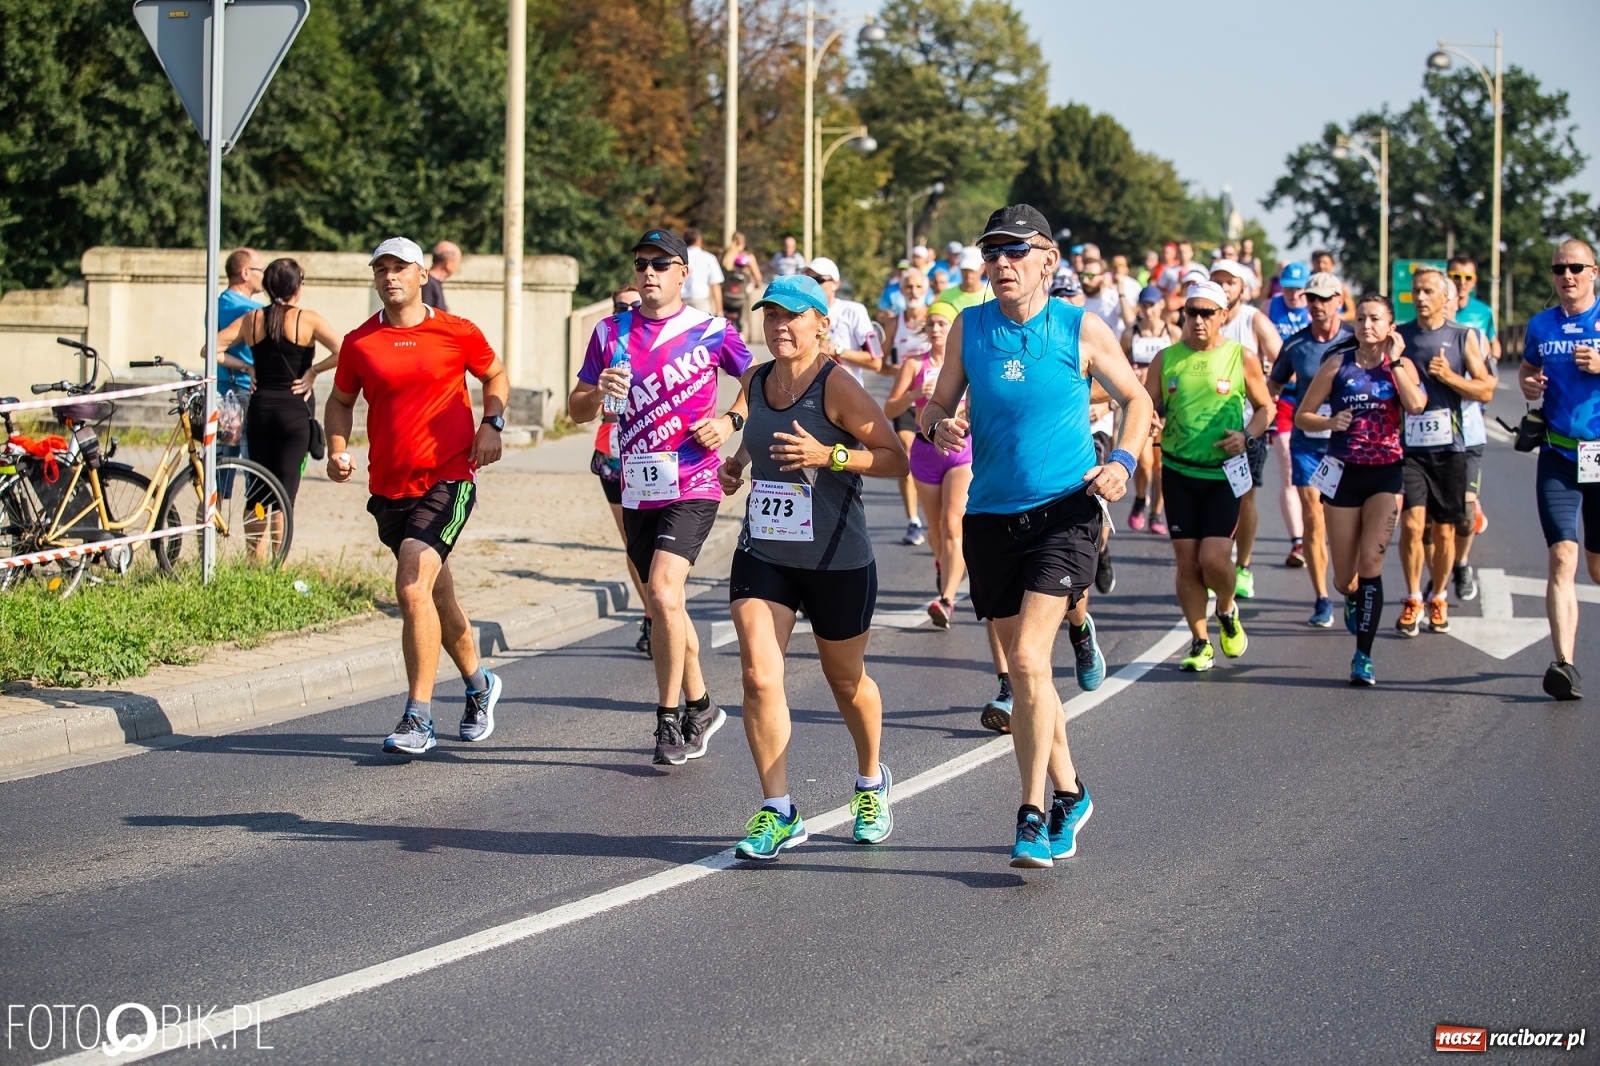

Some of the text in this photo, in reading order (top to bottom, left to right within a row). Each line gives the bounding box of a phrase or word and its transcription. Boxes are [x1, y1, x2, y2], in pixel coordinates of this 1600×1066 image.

[1419, 420, 1439, 432] 153
[642, 466, 658, 481] 13
[761, 497, 794, 517] 273
